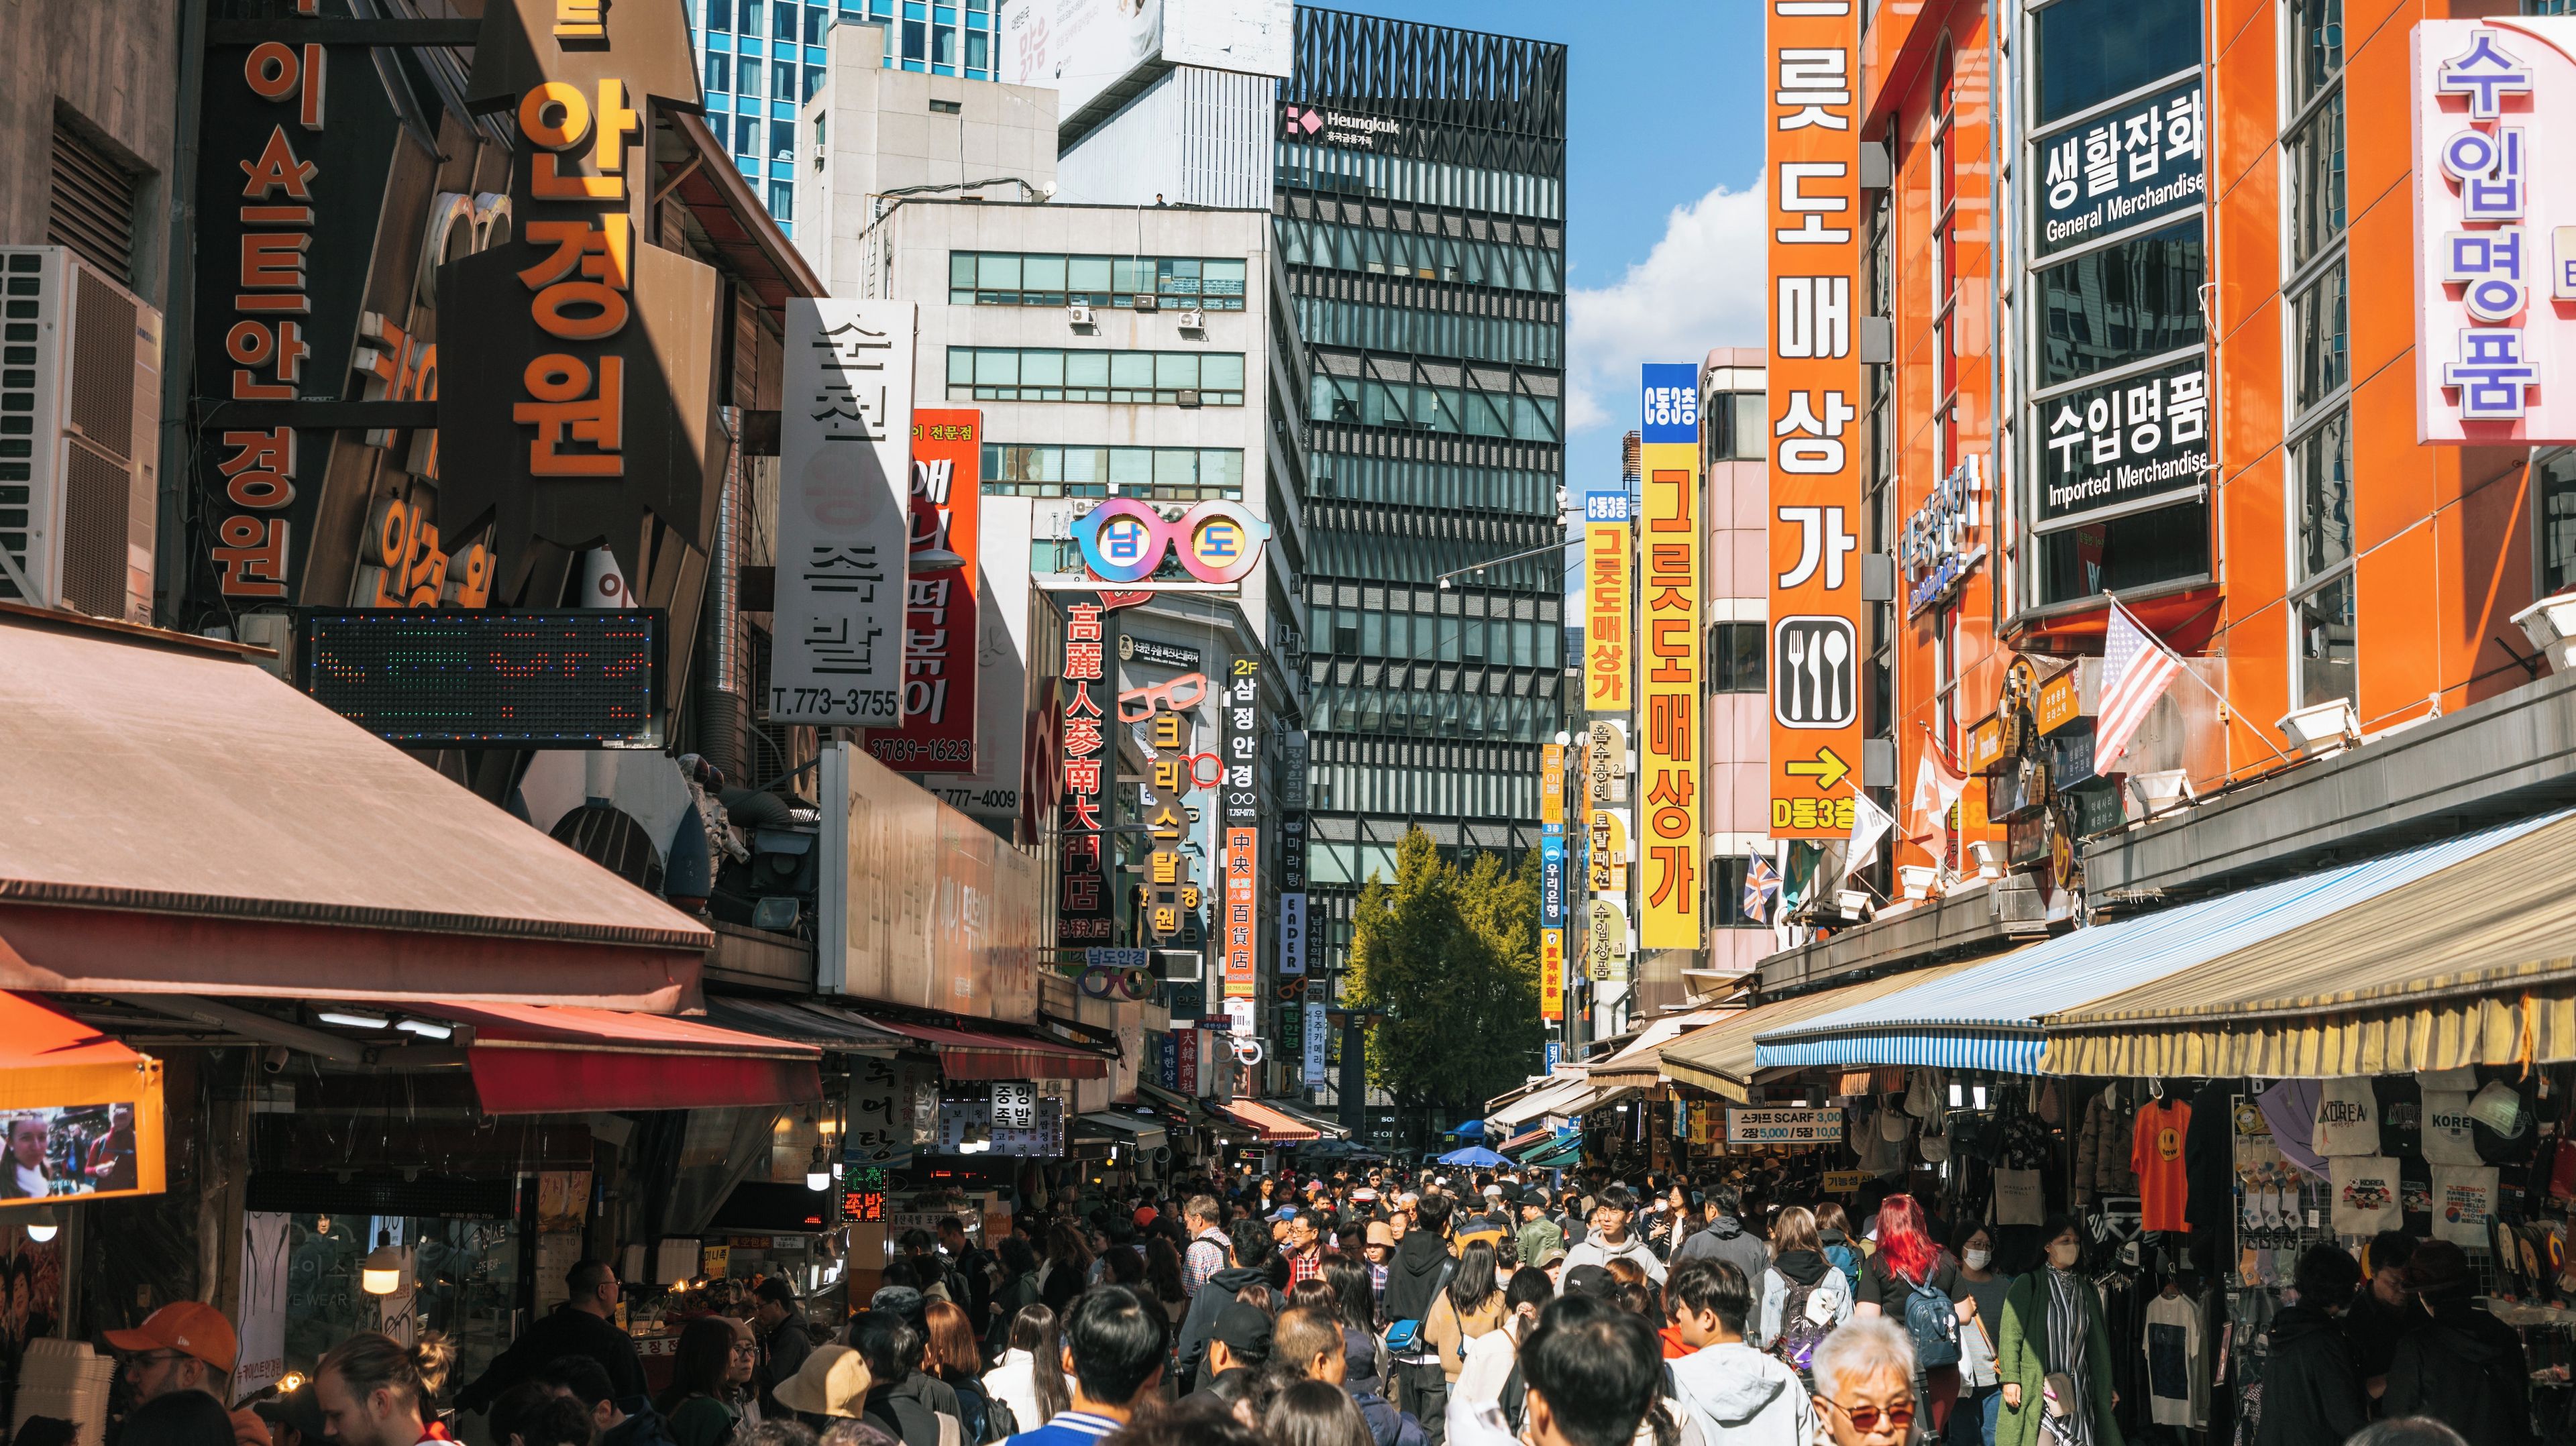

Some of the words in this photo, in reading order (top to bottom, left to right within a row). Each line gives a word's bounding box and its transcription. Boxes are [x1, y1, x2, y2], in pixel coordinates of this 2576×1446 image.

[1328, 111, 1400, 134] Heungkuk
[1327, 131, 1373, 146] 흥국금융가족
[2046, 89, 2204, 210] 생활잡화
[2047, 203, 2102, 241] General
[2108, 172, 2205, 221] Merchandise
[2441, 31, 2539, 418] 수입명품
[213, 0, 327, 598] 이스트안경원
[1774, 0, 1857, 592] 릇도매상가
[1645, 387, 1696, 426] C동3층
[930, 425, 972, 441] 전문점
[2049, 370, 2207, 473] 수입명품
[2049, 469, 2110, 509] Imported
[2116, 450, 2207, 490] Merchandise
[1588, 496, 1627, 518] C동3층
[1592, 530, 1623, 701] 그릇도매상가
[1234, 659, 1258, 675] 2F
[772, 687, 898, 716] T.773-3755
[1648, 469, 1694, 913] 그릇도매상가
[1231, 678, 1256, 788] 삼정안경
[871, 738, 971, 761] 3789-1623
[1593, 725, 1610, 800] 혼수공예
[930, 788, 1016, 808] T777-4009
[1233, 833, 1250, 874] 中央
[1287, 838, 1301, 887] 마라탕
[1593, 814, 1610, 887] 토탈패션
[1546, 863, 1559, 918] 우리은행
[1232, 905, 1251, 970] 百貨店
[1594, 903, 1610, 977] 수입상품
[1088, 948, 1146, 966] 남도안경
[1177, 995, 1201, 1007] 안경
[1313, 1010, 1324, 1066] 우주카메라
[996, 1086, 1032, 1105] 중앙
[995, 1107, 1031, 1126] 족발
[1587, 1110, 1613, 1126] 신발
[1741, 1113, 1772, 1124] 스카프
[1774, 1113, 1814, 1123] SCARF
[2389, 1105, 2421, 1123] KORE
[2432, 1115, 2471, 1128] KORE
[1741, 1127, 1758, 1138] 2장
[1760, 1127, 1788, 1139] 5,000
[1796, 1127, 1813, 1138] 5장
[1828, 1177, 1859, 1186] 기능성
[845, 1192, 883, 1218] 족발
[307, 1292, 347, 1306] WEAR
